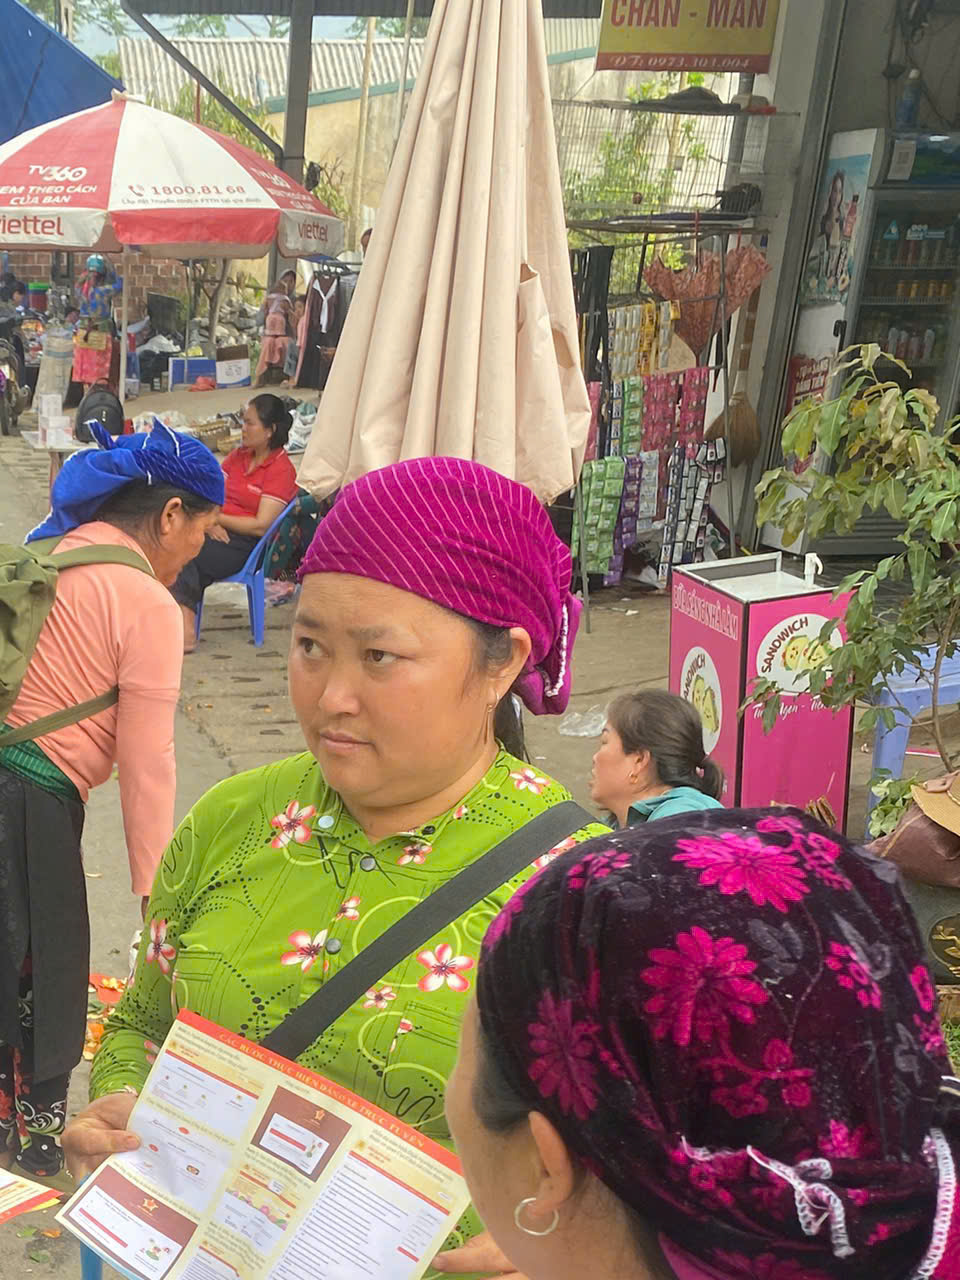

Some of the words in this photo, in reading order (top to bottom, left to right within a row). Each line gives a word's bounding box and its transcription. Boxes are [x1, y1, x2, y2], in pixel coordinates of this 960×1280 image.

[28, 165, 87, 181] TV360
[28, 185, 65, 194] THEO
[66, 183, 97, 193] CÁCH
[761, 617, 809, 673] SANDWICH
[684, 653, 706, 701] ANDWICH
